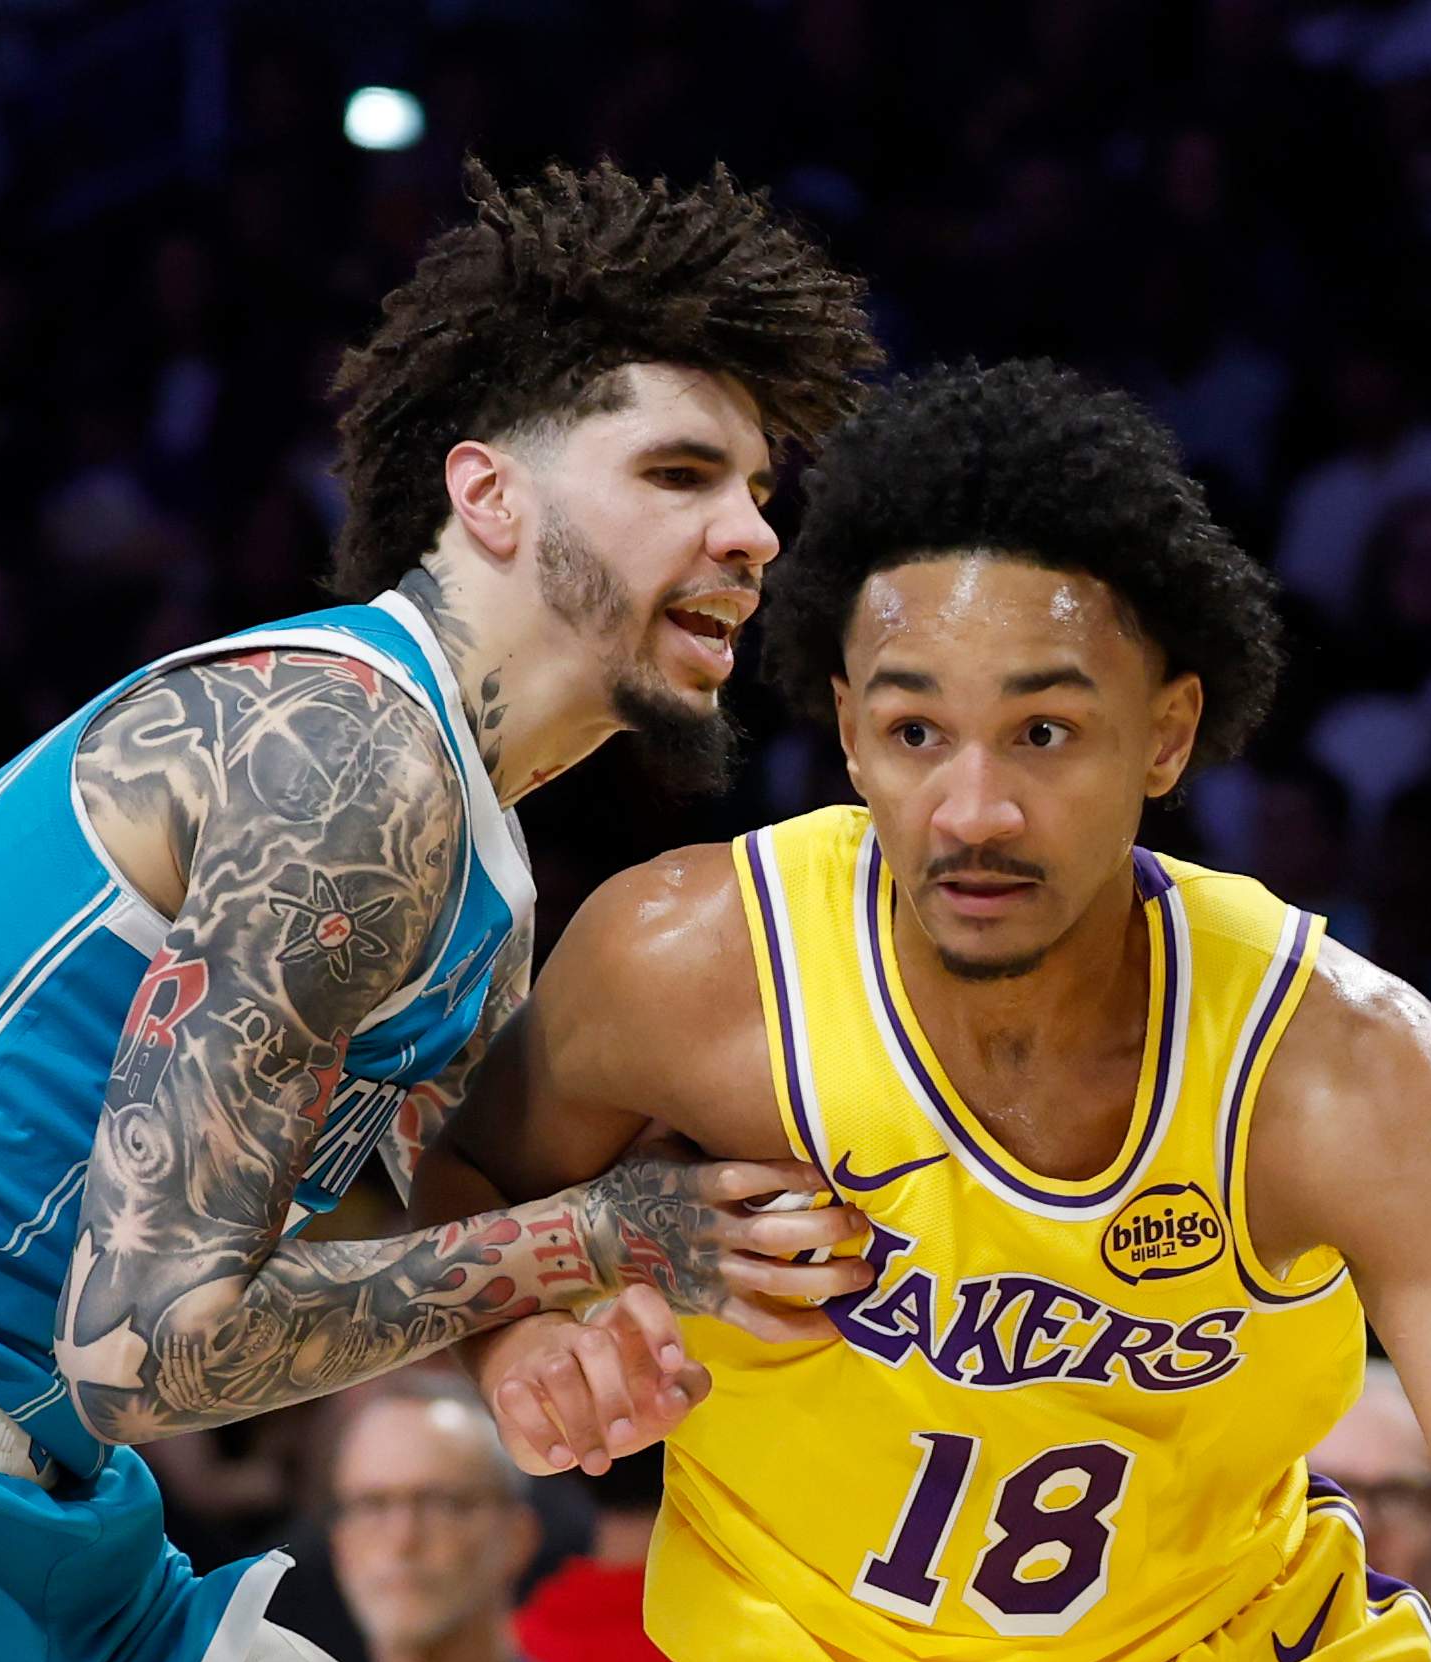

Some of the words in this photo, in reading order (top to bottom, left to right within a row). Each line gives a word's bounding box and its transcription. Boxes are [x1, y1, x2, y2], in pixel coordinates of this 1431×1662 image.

[1113, 1207, 1219, 1252] bibigo
[1130, 1241, 1178, 1262] 비비고
[819, 1218, 1251, 1393] LAKERS
[851, 1430, 1137, 1636] 18
